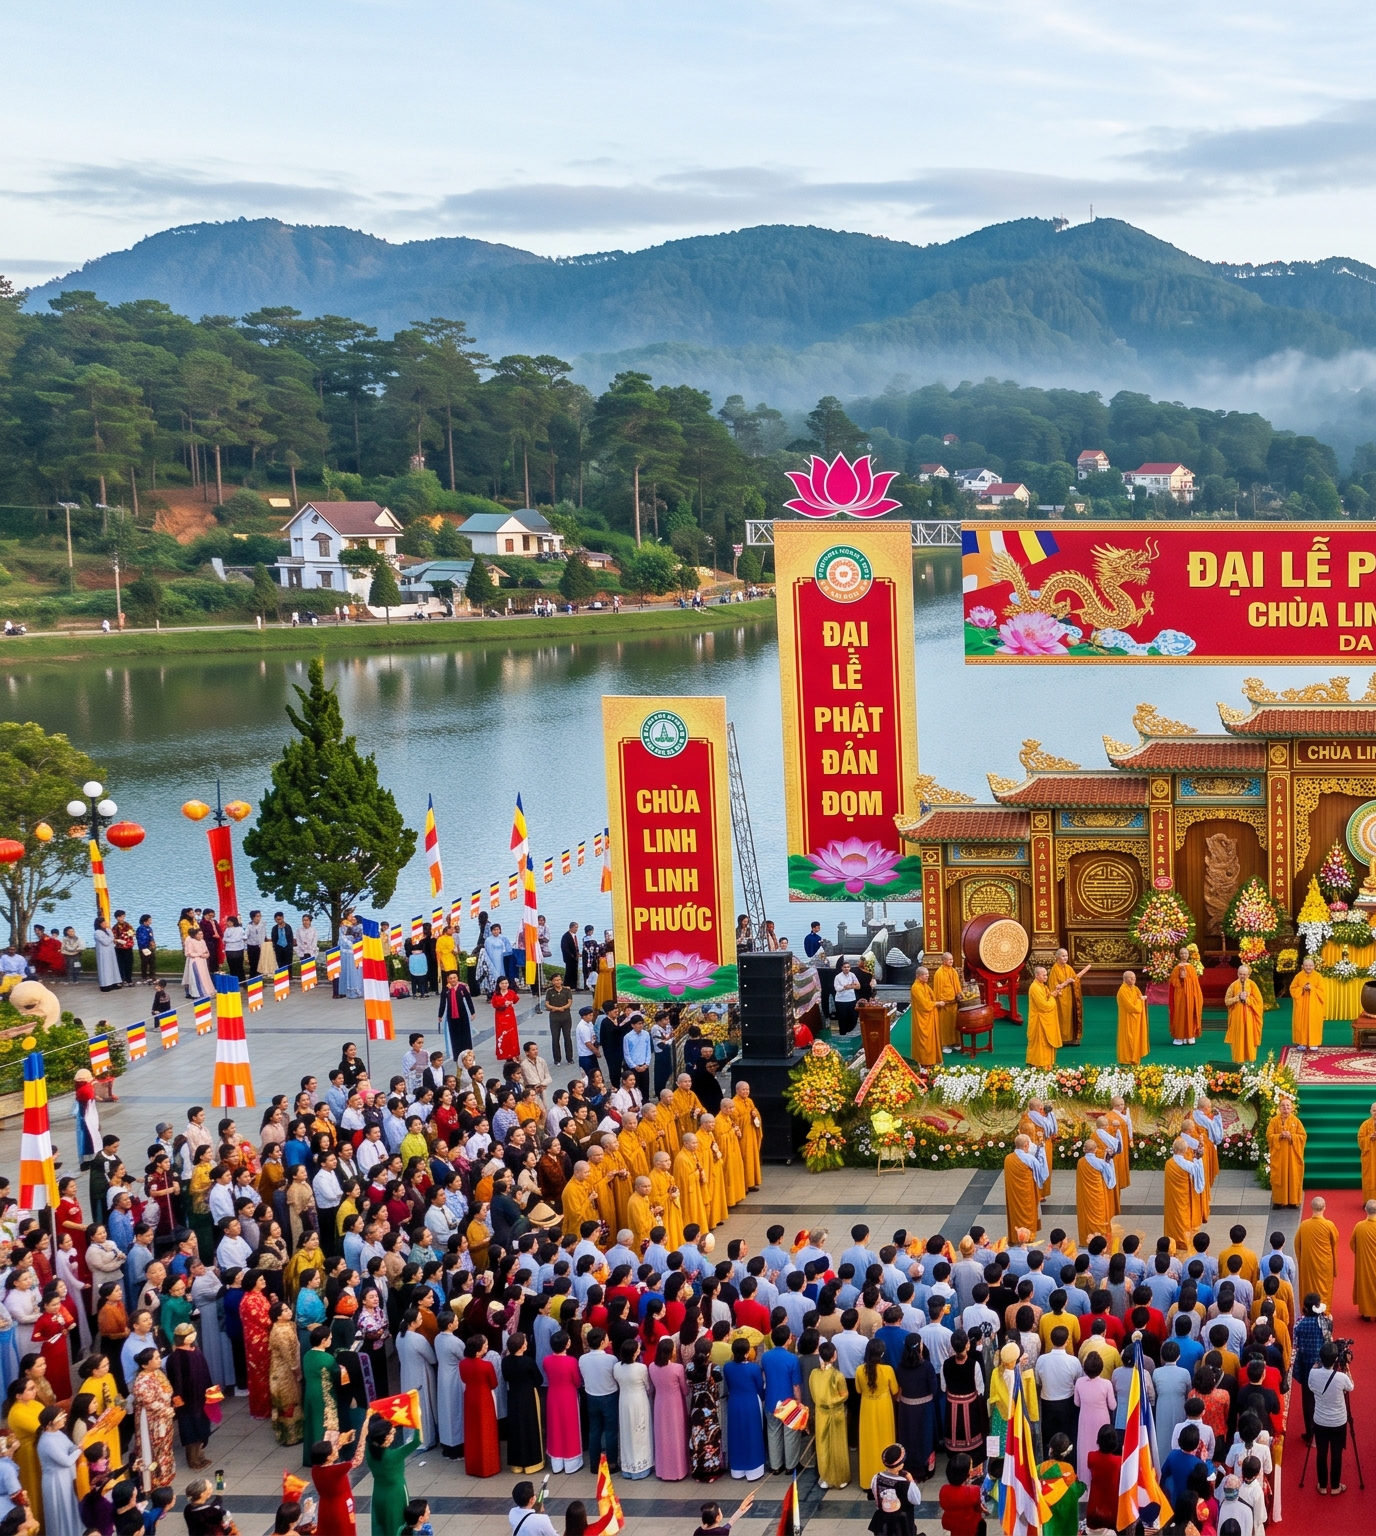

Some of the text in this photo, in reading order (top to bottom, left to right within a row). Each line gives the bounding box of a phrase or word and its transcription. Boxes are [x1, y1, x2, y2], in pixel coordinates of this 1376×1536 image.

[1187, 551, 1264, 596] ĐẠI
[1281, 535, 1332, 588] LỄ
[1248, 595, 1329, 628] CHÙA
[822, 621, 869, 653] ĐẠI
[1339, 634, 1374, 651] DA
[831, 653, 864, 690] LỄ
[814, 701, 884, 739] PHẬT
[822, 740, 878, 775] ĐẢN
[1307, 742, 1352, 760] CHÙA
[636, 784, 701, 814] CHÙA
[822, 790, 883, 822] ĐỌM
[643, 828, 697, 853] LINH
[645, 868, 698, 893] LINH
[633, 902, 713, 932] PHƯỚC
